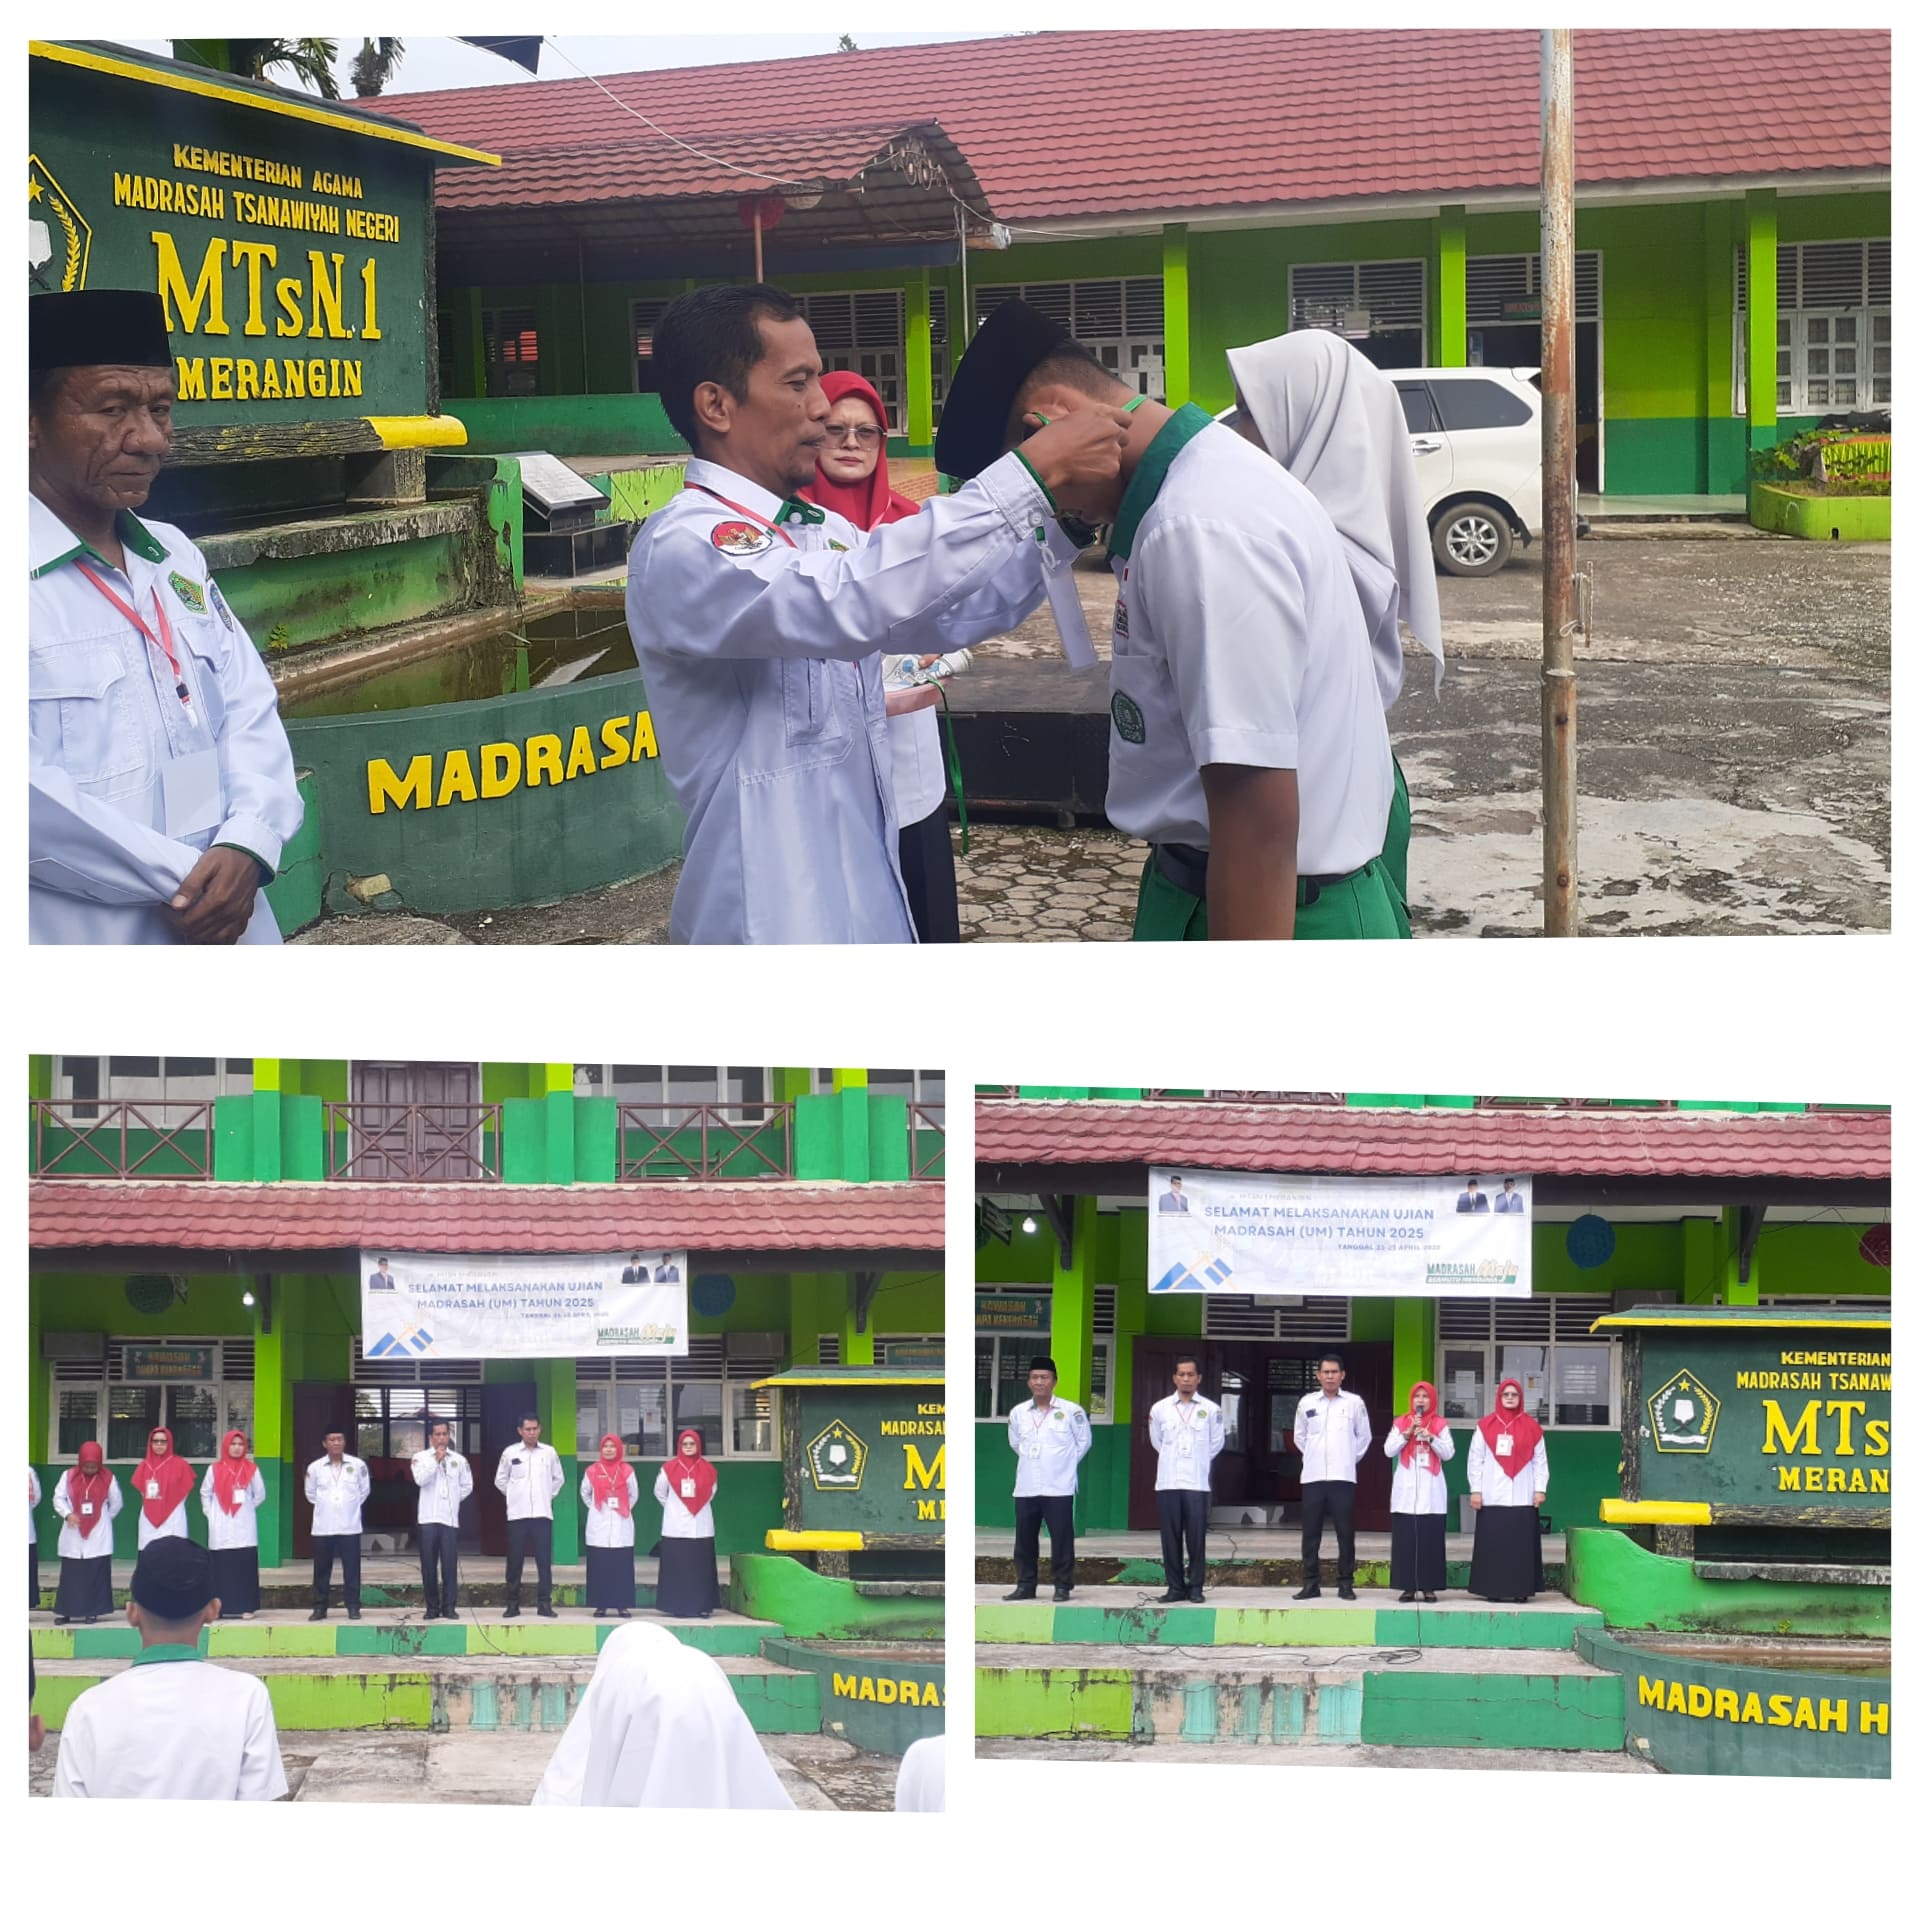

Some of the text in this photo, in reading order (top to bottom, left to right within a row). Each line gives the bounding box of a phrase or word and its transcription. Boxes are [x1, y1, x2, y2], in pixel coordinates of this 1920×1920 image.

[173, 143, 364, 200] KEMENTERIAN AGAMA
[113, 171, 400, 243] MADRASAH TSANAWIYAH NEGERI
[175, 356, 363, 401] MERANGIN
[367, 710, 660, 815] MADRASA
[1204, 1205, 1434, 1220] SELAMAT MELAKSANAKAN UJIAN
[1214, 1224, 1424, 1239] MADRASAH (UM) TAHUN 2025
[1426, 1263, 1476, 1275] MADRASAH
[408, 1281, 603, 1293] SELAMAT MELAKSANAKAN UJIAN
[417, 1297, 594, 1310] MADRASAH (UM) TAHUN 2025
[1780, 1351, 1891, 1367] KEMENTERIAN
[1736, 1370, 1822, 1391] MADRASAH
[1762, 1399, 1889, 1457] MTs
[1778, 1465, 1890, 1494] MERAN
[833, 1672, 946, 1708] MADRA
[1638, 1675, 1889, 1735] MADRASAH H
